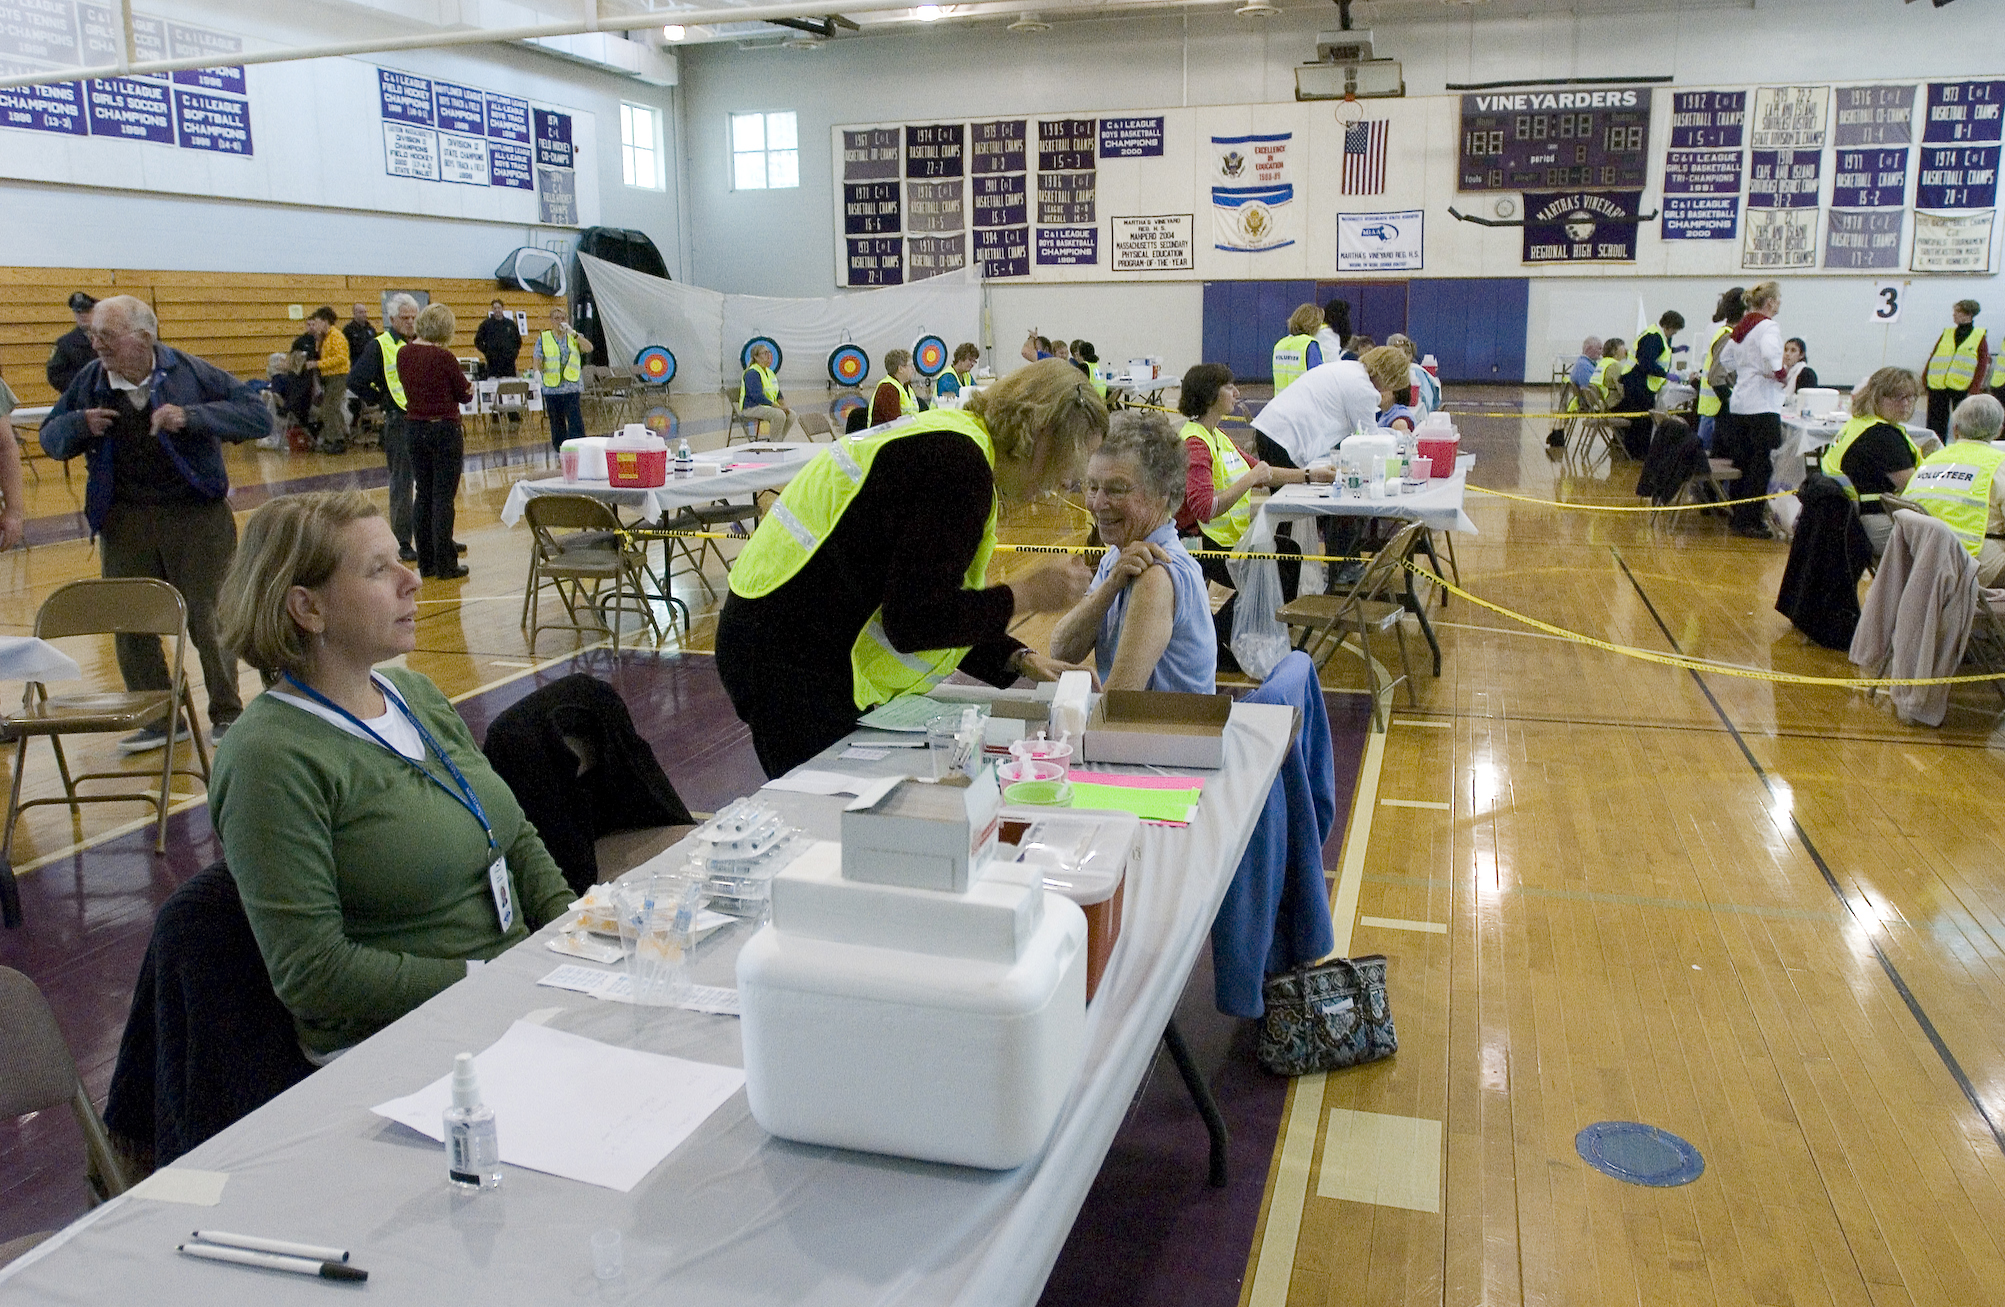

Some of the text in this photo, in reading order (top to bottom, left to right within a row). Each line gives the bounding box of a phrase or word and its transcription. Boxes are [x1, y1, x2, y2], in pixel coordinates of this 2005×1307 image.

[34, 84, 75, 102] TENNIS
[119, 84, 164, 101] LEAGUE
[0, 95, 80, 117] CHAMPIONS
[92, 92, 169, 115] GIRLS SOCCER
[384, 93, 431, 110] CHAMPIONS
[1476, 91, 1637, 111] VINEYARDERS
[204, 99, 243, 115] LEAGUE
[94, 107, 169, 129] CHAMPIONS
[182, 108, 246, 128] SOFTBALL
[440, 106, 482, 123] CHAMPIONS
[1124, 119, 1158, 129] LEAGUE
[182, 122, 248, 142] CHAMPIONS
[1101, 128, 1162, 139] BOYS BASKETBALL
[1105, 138, 1159, 148] CHAMPIONS
[1120, 148, 1143, 156] 2000
[1697, 152, 1737, 162] LEAGUE
[1530, 154, 1555, 165] period
[1690, 162, 1741, 172] BASKETBALL
[1671, 173, 1735, 183] TRI-CHAMPIONS
[1536, 195, 1580, 221] MARTHA'S
[1693, 199, 1730, 209] LEAGUE
[1664, 209, 1736, 219] GIRLS BASKETBALL
[1667, 219, 1732, 230] CHAMPIONS
[1060, 229, 1091, 238] LEAGUE
[1685, 229, 1711, 238] 2000
[1038, 237, 1096, 248] BOYS BASKETBALL
[1116, 240, 1158, 250] MASSACHUSETTS
[1041, 247, 1093, 256] CHAMPIONS
[1121, 249, 1184, 259] PHYSICAL EDUCATION
[1531, 243, 1629, 259] REGIONAL HIGH SCHOOL
[1877, 287, 1898, 318] 3
